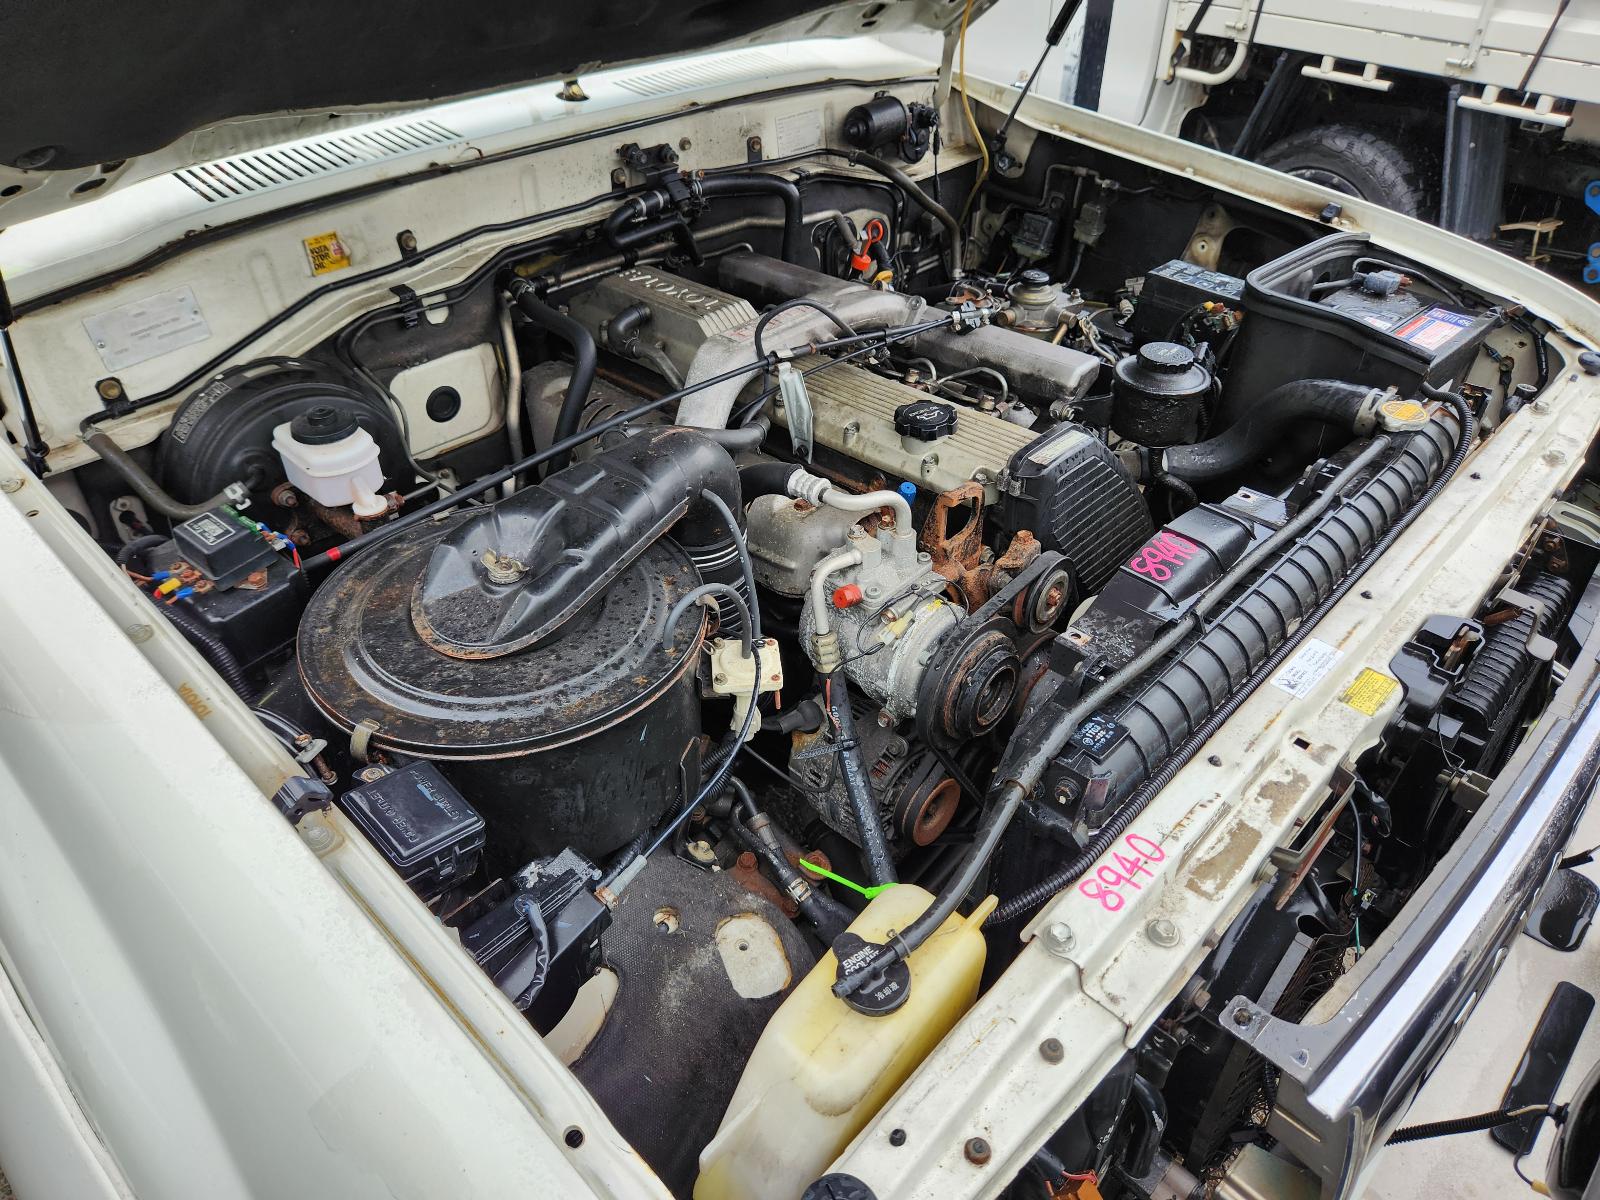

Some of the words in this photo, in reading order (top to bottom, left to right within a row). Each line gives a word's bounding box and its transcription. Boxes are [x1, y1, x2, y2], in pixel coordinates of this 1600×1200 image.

[1131, 532, 1199, 582] 8940
[1078, 832, 1166, 912] 8940
[842, 945, 873, 969] ENGINE
